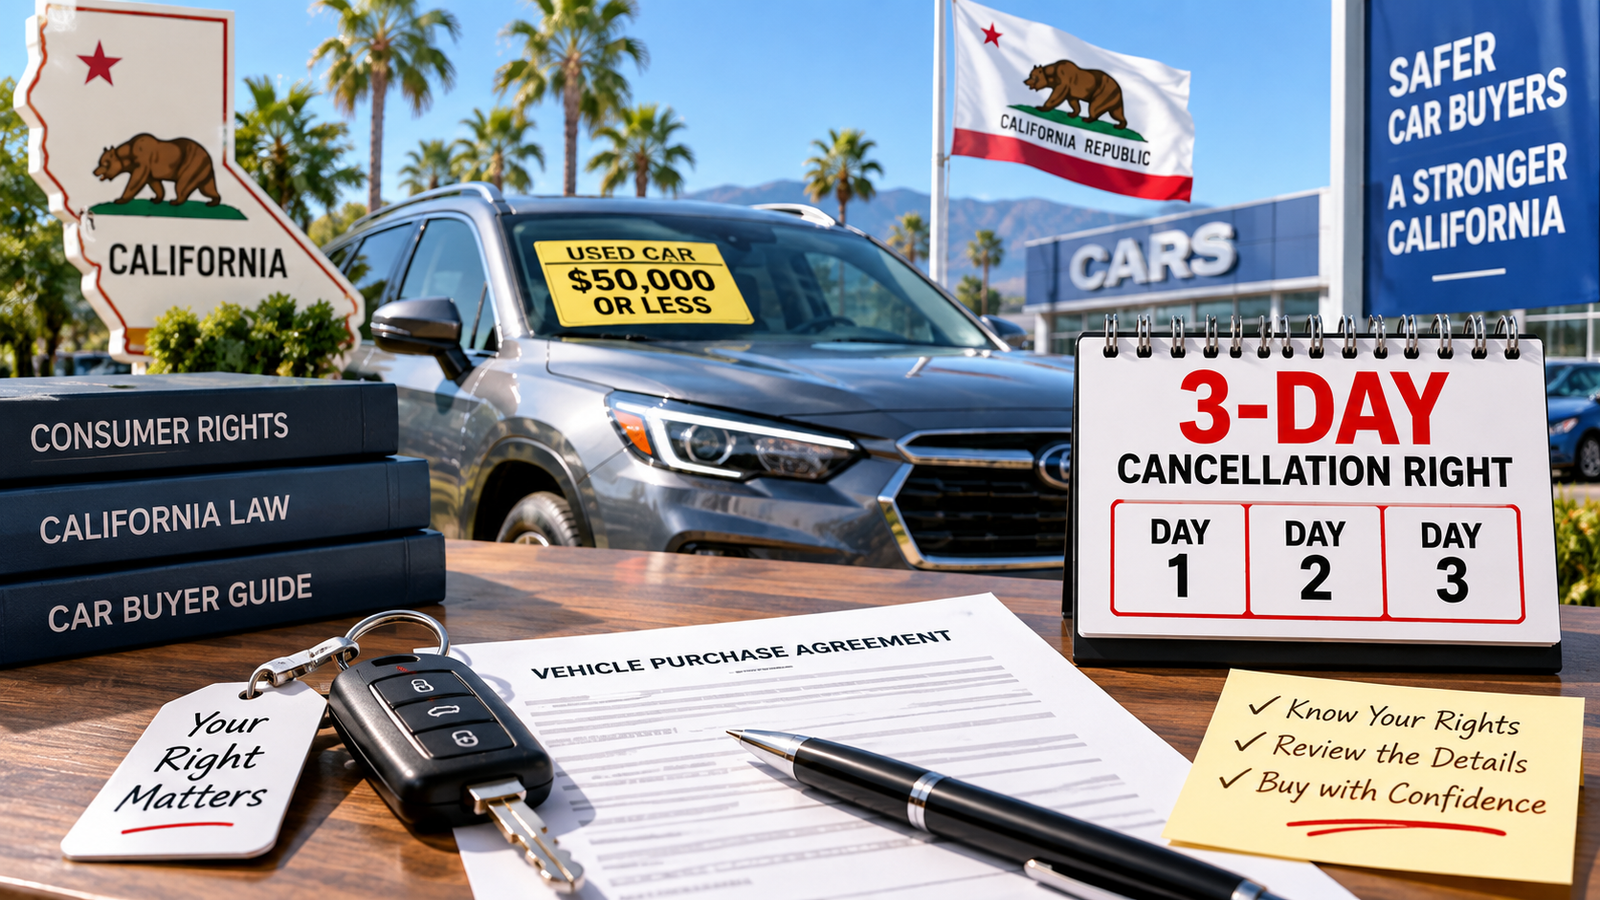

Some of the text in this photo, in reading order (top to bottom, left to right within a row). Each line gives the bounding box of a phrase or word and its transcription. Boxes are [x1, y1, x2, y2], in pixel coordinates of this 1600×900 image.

[1389, 31, 1496, 98] SAFER
[1388, 67, 1568, 144] CAR BUYERS
[1000, 114, 1151, 167] CALIFORNIA REPUBLIC
[1387, 142, 1568, 210] A STRONGER
[1387, 195, 1566, 256] CALIFORNIA
[108, 243, 288, 278] CALIFORNIA
[566, 247, 696, 262] USED CAR
[1069, 222, 1236, 291] CARS
[567, 267, 716, 295] $50,000
[593, 296, 712, 316] OR LESS
[1178, 369, 1449, 446] 3-DAY
[30, 412, 289, 452] CONSUMER RIGHTS
[1117, 453, 1513, 488] CANCELLATION RIGHT
[39, 495, 291, 545] CALIFORNIA LAW
[1150, 519, 1210, 544] DAY
[1285, 521, 1346, 547] DAY
[1421, 522, 1482, 549] DAY
[1168, 553, 1189, 598] 1
[1299, 555, 1332, 600] 2
[1435, 557, 1469, 603] 3
[48, 573, 313, 633] CAR BUYER GUIDE
[531, 629, 952, 681] VEHICLE PURCHASE AGREEMENT
[187, 711, 270, 738] Your
[1285, 698, 1520, 739] Know Your Rights
[154, 743, 265, 781] Right
[1273, 734, 1528, 774] Review the Details
[114, 784, 268, 812] Matters
[1256, 771, 1547, 815] Buy with Confidence
